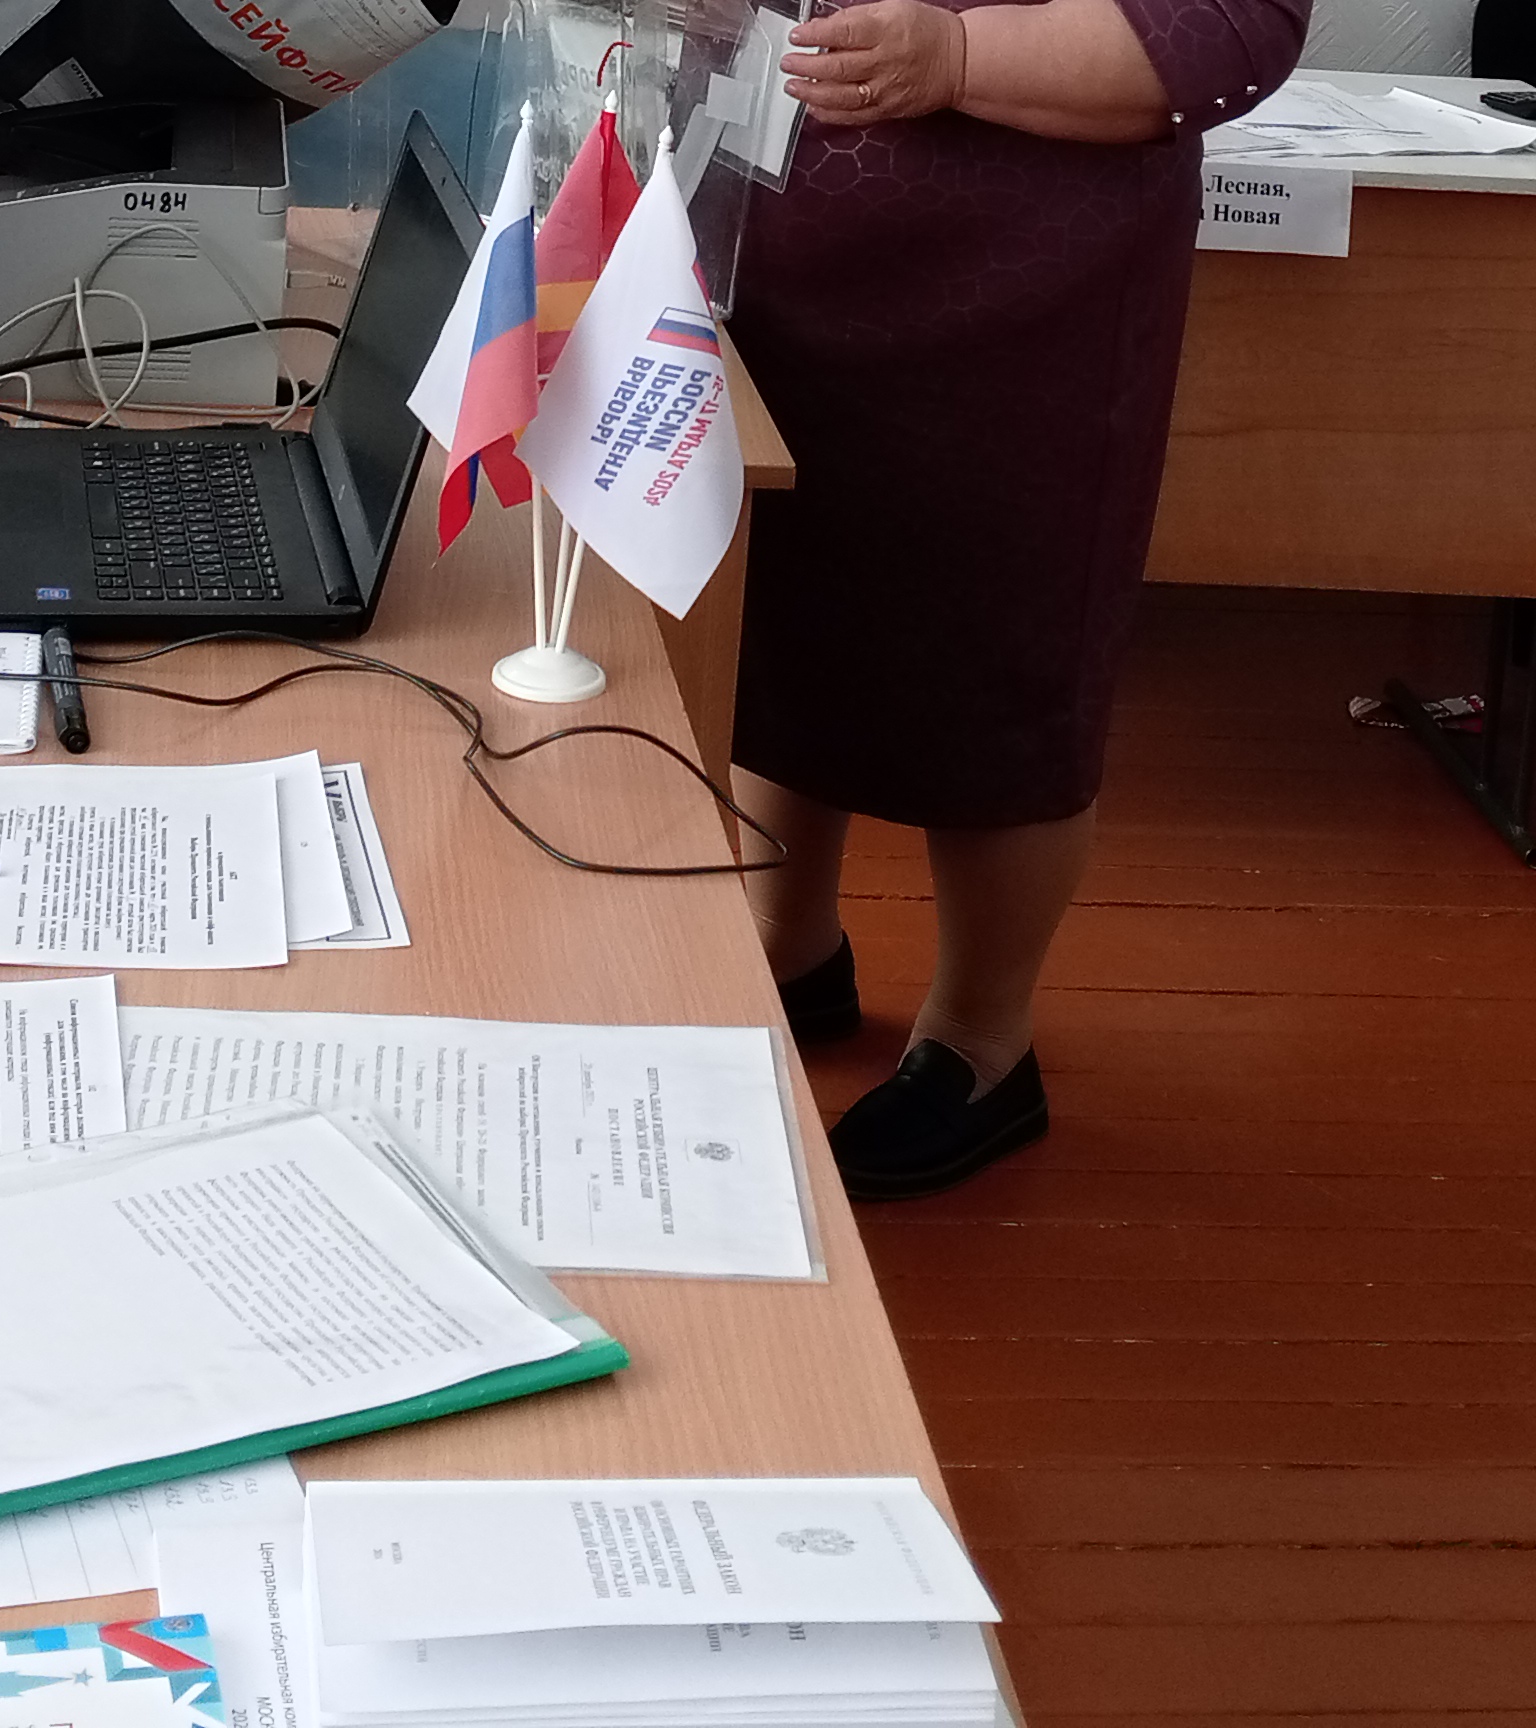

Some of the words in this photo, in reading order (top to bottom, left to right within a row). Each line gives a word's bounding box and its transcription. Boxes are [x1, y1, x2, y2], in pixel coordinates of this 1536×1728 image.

[123, 190, 188, 214] 0484
[1205, 174, 1292, 201] Лесная,
[1213, 203, 1281, 226] Новая
[691, 1500, 733, 1561] ФЕДЕРАЛЬНЫЙ
[716, 1562, 743, 1595] ЗАКОН
[259, 1542, 281, 1619] Центральная
[268, 1622, 295, 1704] избирательная
